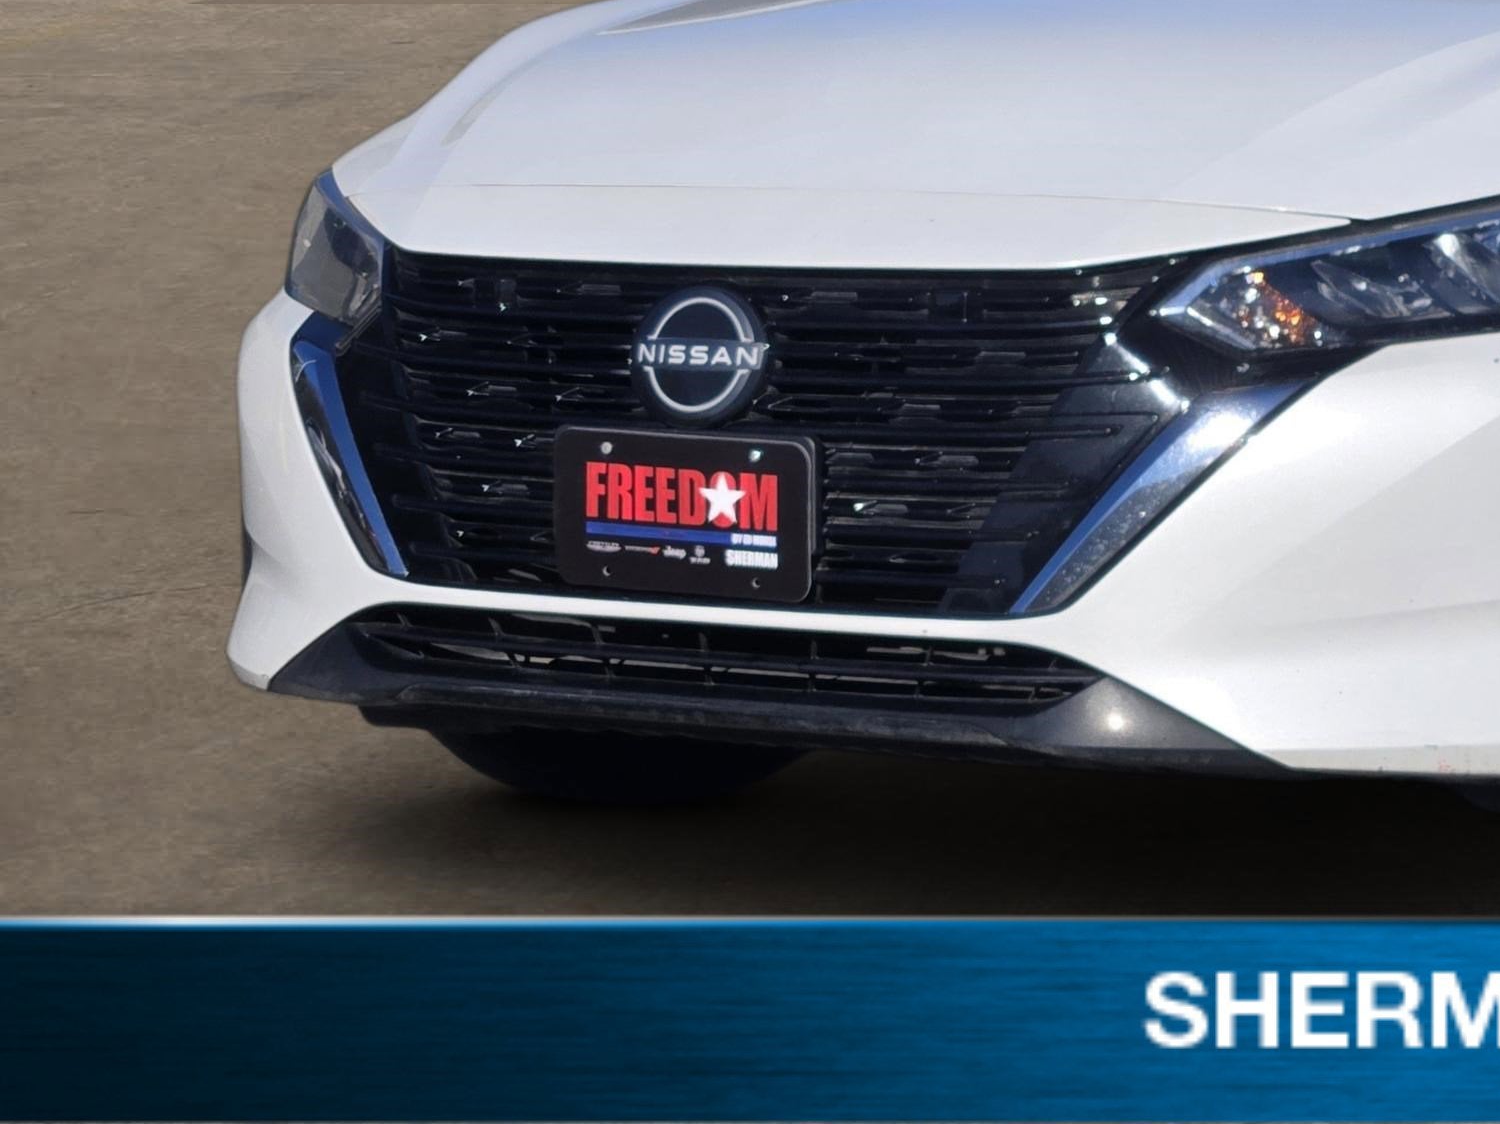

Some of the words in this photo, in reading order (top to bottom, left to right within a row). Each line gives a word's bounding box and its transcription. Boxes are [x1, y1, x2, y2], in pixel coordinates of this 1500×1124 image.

[637, 342, 760, 367] NISSAN
[584, 461, 779, 532] FREEDOM
[725, 549, 779, 570] SHERMAN
